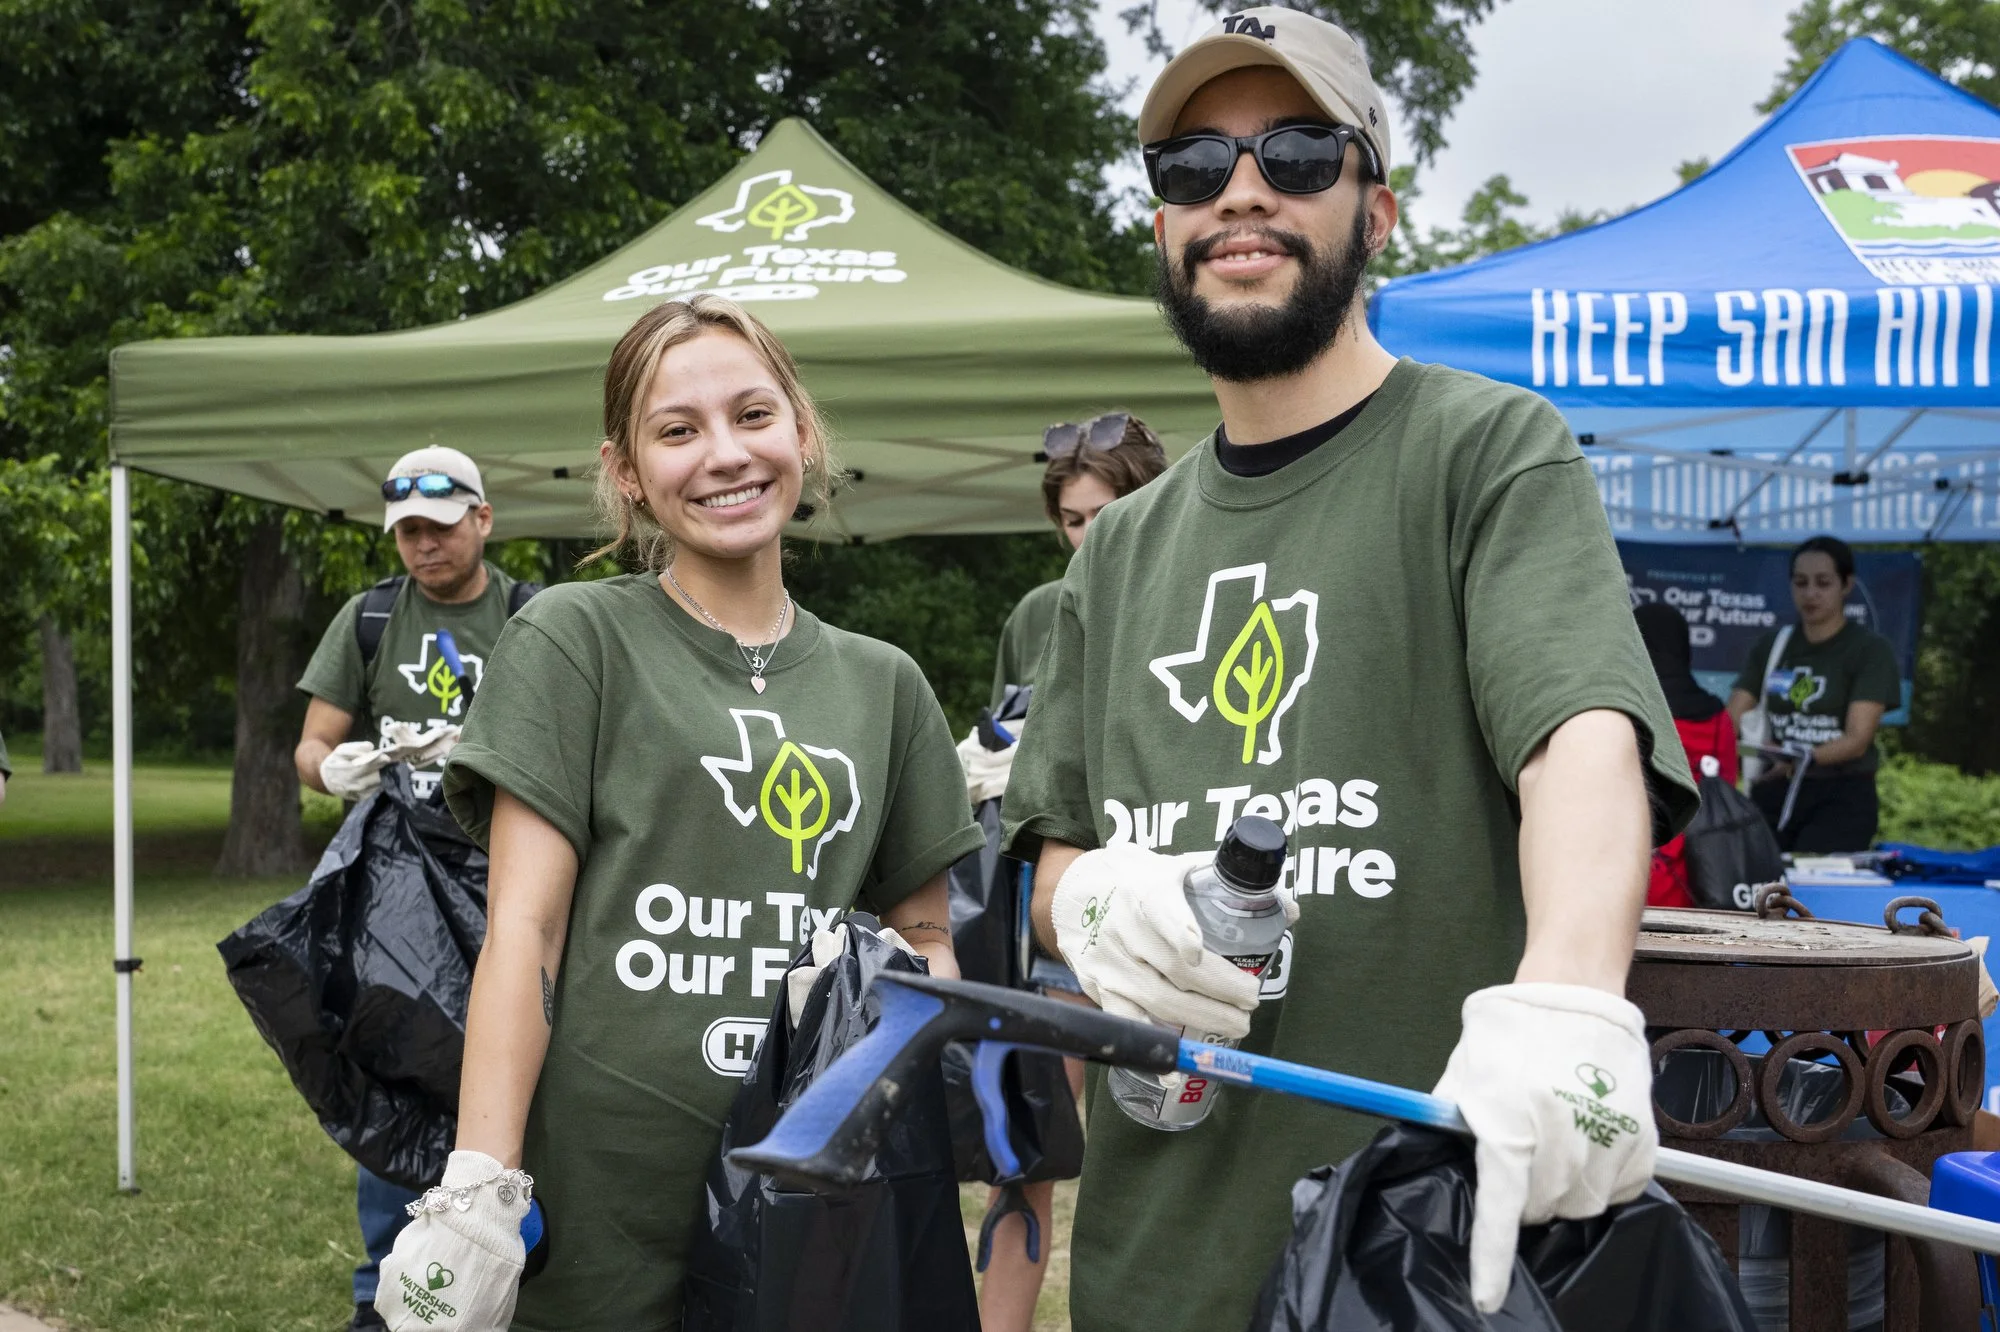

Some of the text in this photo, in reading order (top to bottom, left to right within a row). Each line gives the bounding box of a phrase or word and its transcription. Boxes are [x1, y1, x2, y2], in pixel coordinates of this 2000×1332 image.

[602, 275, 709, 301] Our
[717, 265, 907, 286] Future
[628, 245, 897, 286] Our Texas
[1531, 288, 1688, 387] KEEP
[1716, 288, 1849, 387] SAN
[1663, 586, 1766, 610] Our Texas
[1680, 605, 1776, 627] ur Future
[1205, 778, 1379, 842] Texas
[635, 883, 845, 945] Our Tex
[615, 939, 735, 996] Our
[1573, 1108, 1620, 1148] WISE
[400, 1271, 457, 1318] WATERSHED
[402, 1290, 438, 1325] WISE
